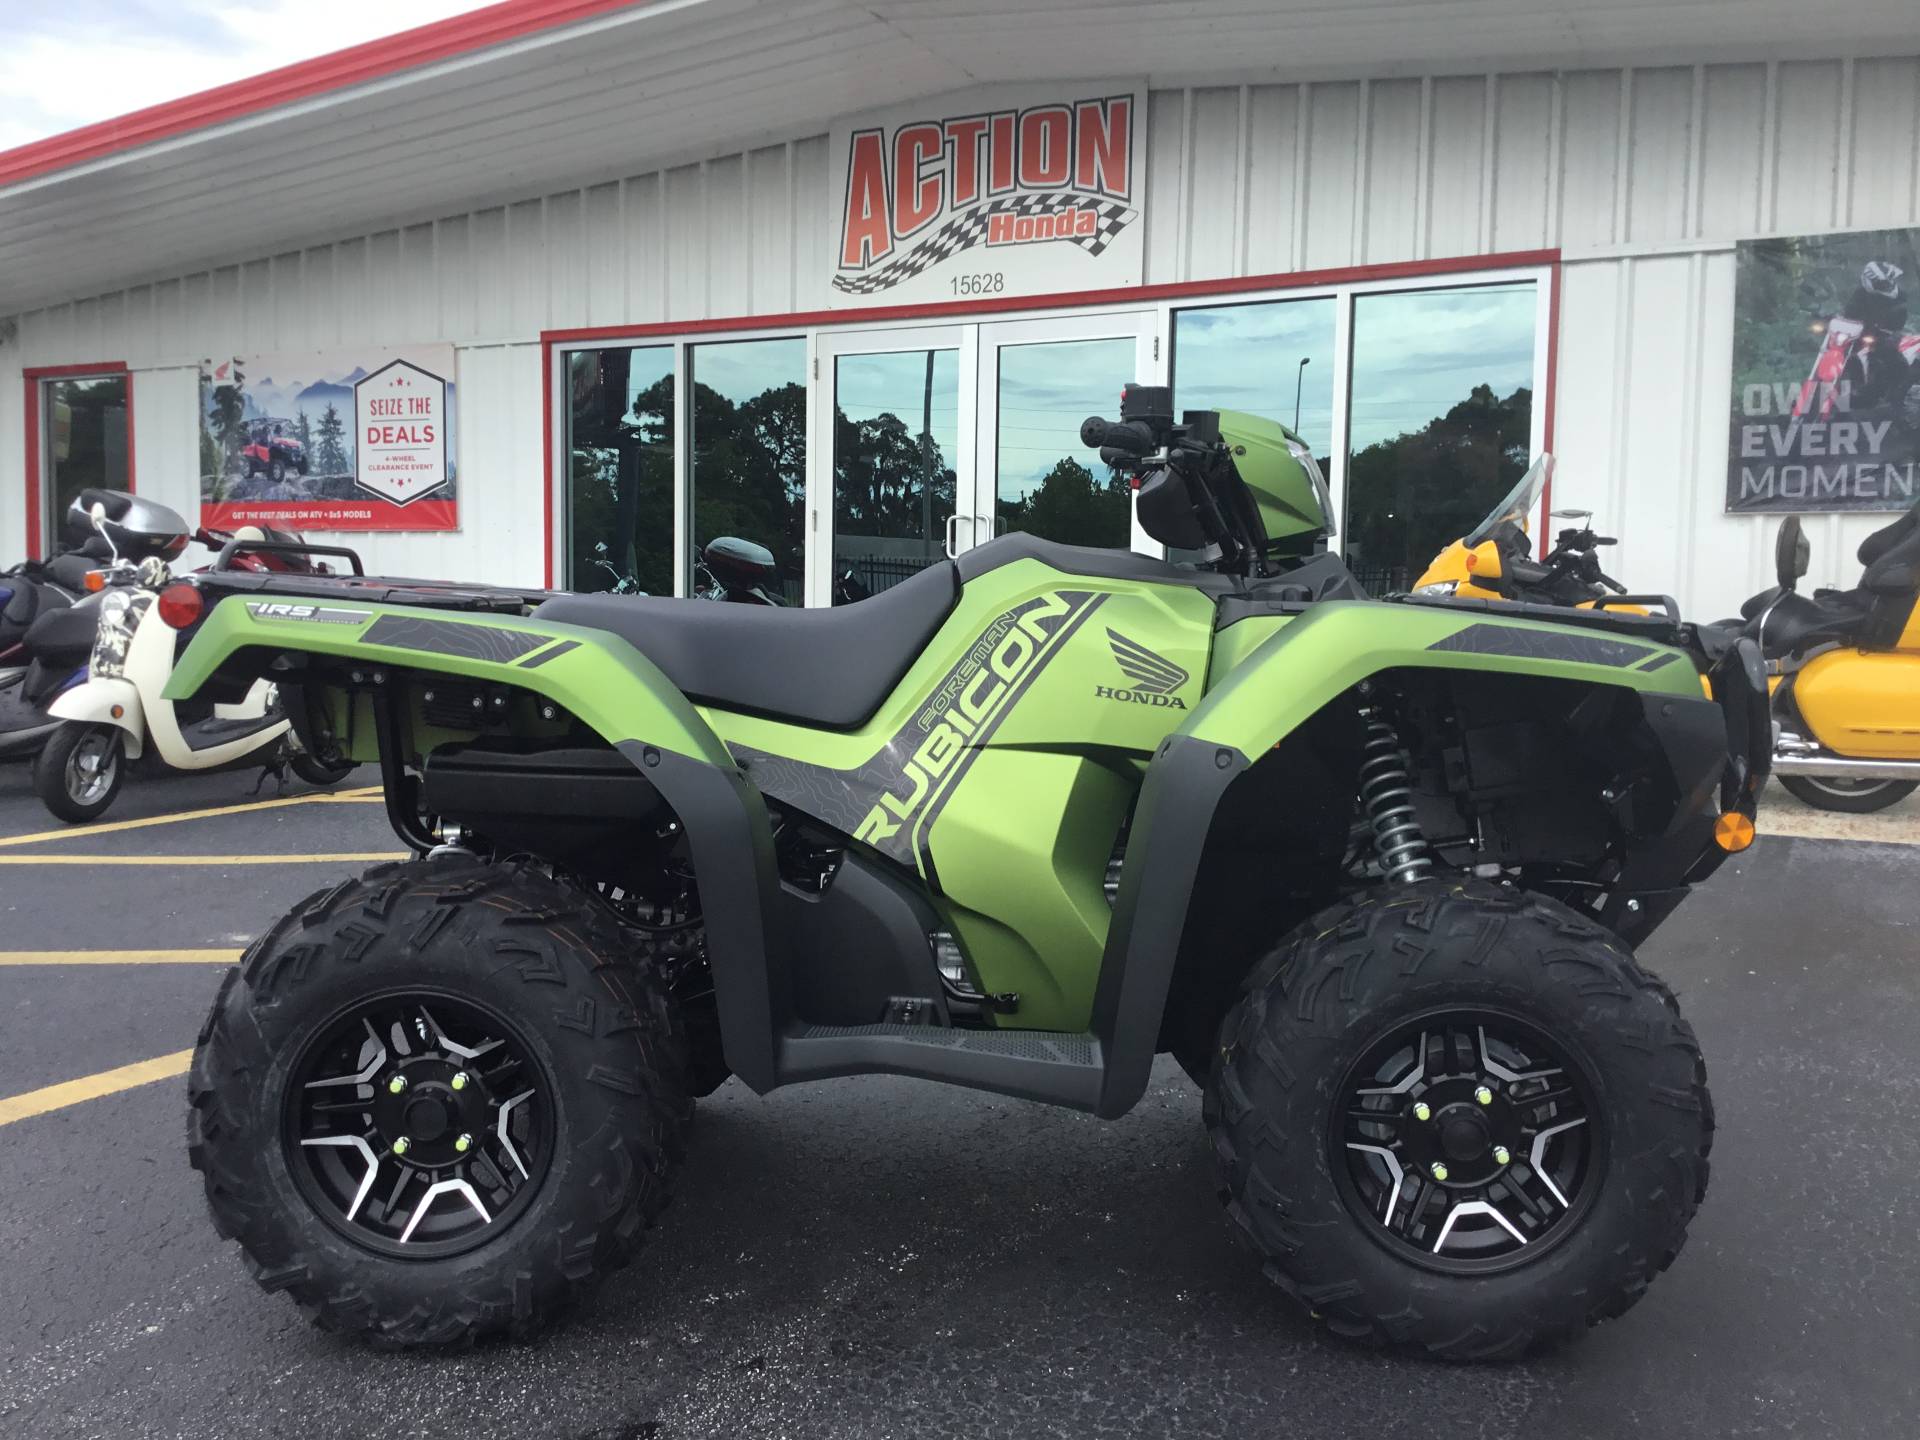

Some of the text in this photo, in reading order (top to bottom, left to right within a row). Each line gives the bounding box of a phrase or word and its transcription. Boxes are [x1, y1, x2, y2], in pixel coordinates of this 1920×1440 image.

[838, 93, 1135, 270] ACTION
[985, 205, 1099, 247] Honda
[950, 272, 1004, 295] 15628
[370, 397, 431, 416] SEIZE THE
[367, 425, 434, 444] DEALS
[1741, 420, 1892, 457] EVERY
[1740, 463, 1920, 499] MOMEN
[258, 603, 315, 617] IRS
[917, 611, 1016, 732] FOREMAN
[1095, 685, 1188, 710] HONDA
[853, 591, 1072, 845] RUBICON
